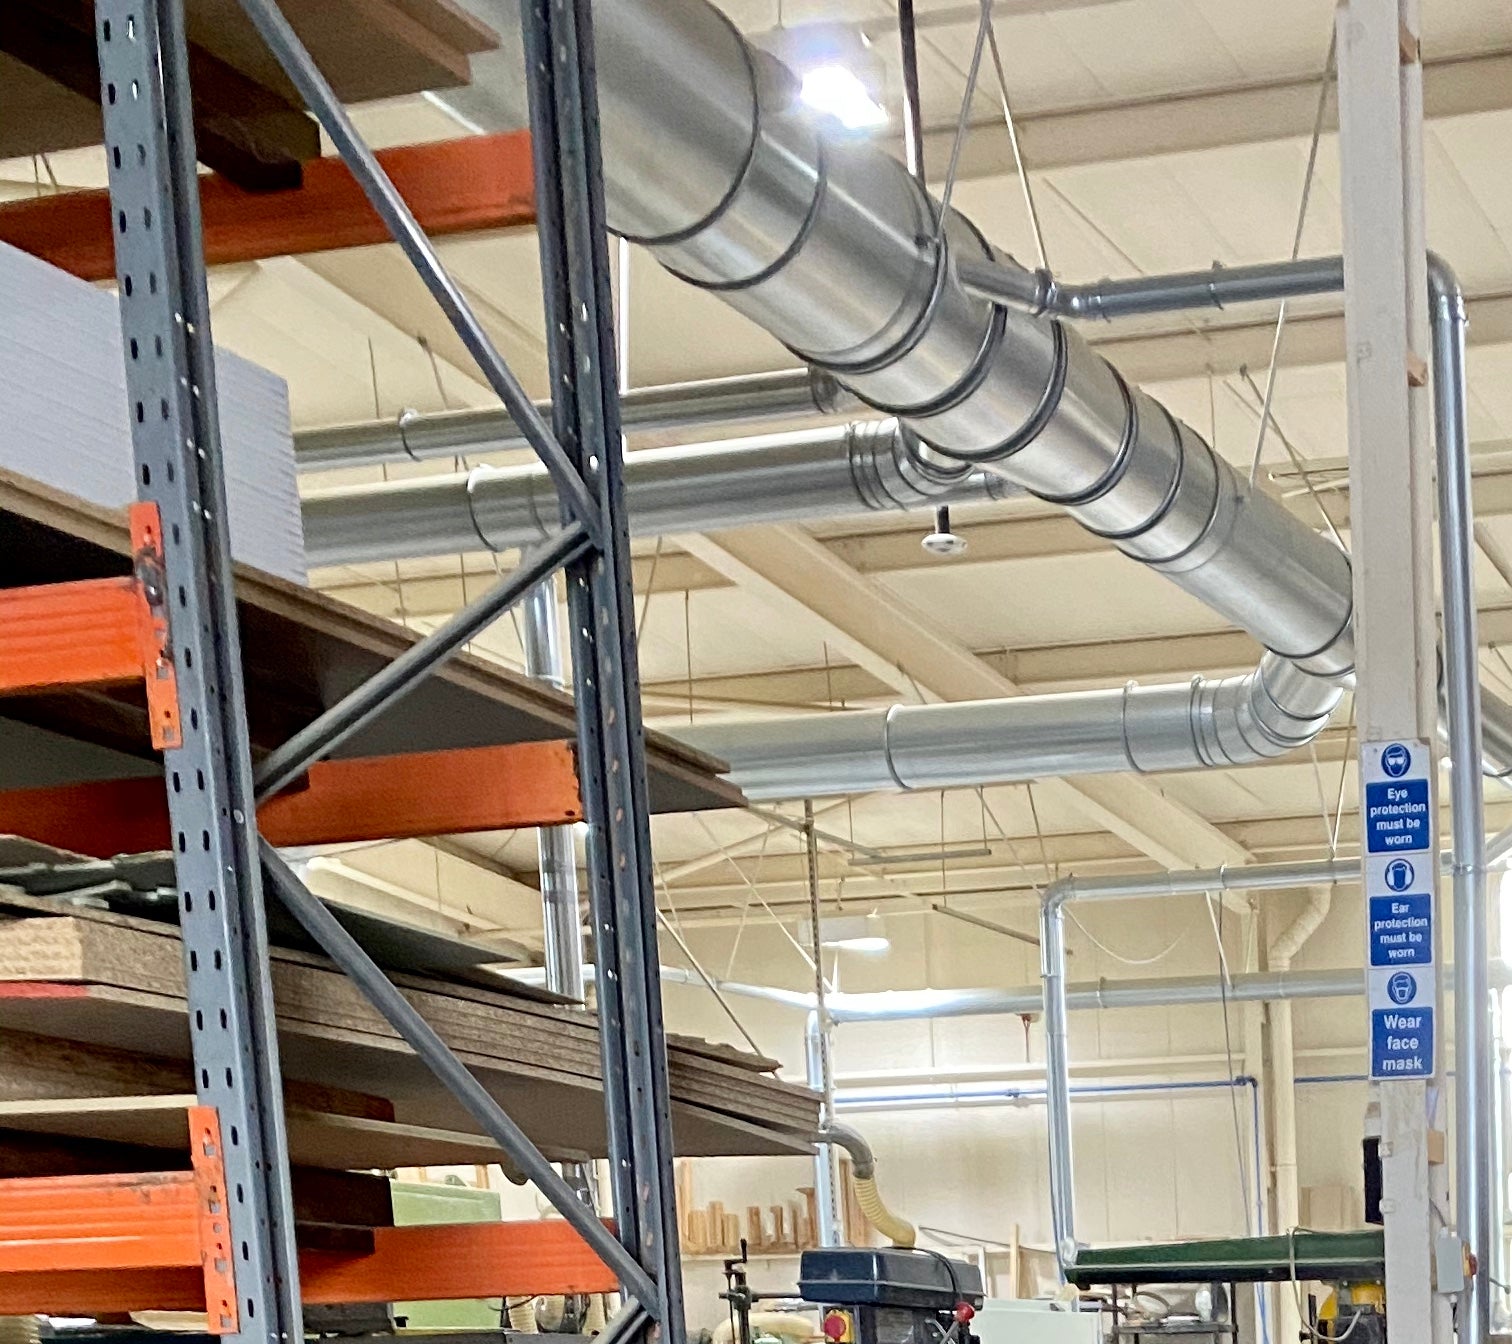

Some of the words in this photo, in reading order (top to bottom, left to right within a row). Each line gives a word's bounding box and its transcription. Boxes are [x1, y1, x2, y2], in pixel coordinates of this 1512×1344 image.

[1387, 788, 1408, 801] Eye
[1370, 802, 1426, 818] protection
[1376, 819, 1404, 830] must
[1406, 817, 1420, 829] be
[1385, 834, 1413, 846] worn
[1391, 902, 1410, 914] Ear
[1374, 916, 1428, 932] protection
[1380, 932, 1407, 944] must
[1409, 931, 1423, 942] be
[1388, 948, 1415, 958] worn
[1383, 1014, 1422, 1030] Wear
[1386, 1035, 1419, 1050] face
[1382, 1055, 1423, 1071] mask
